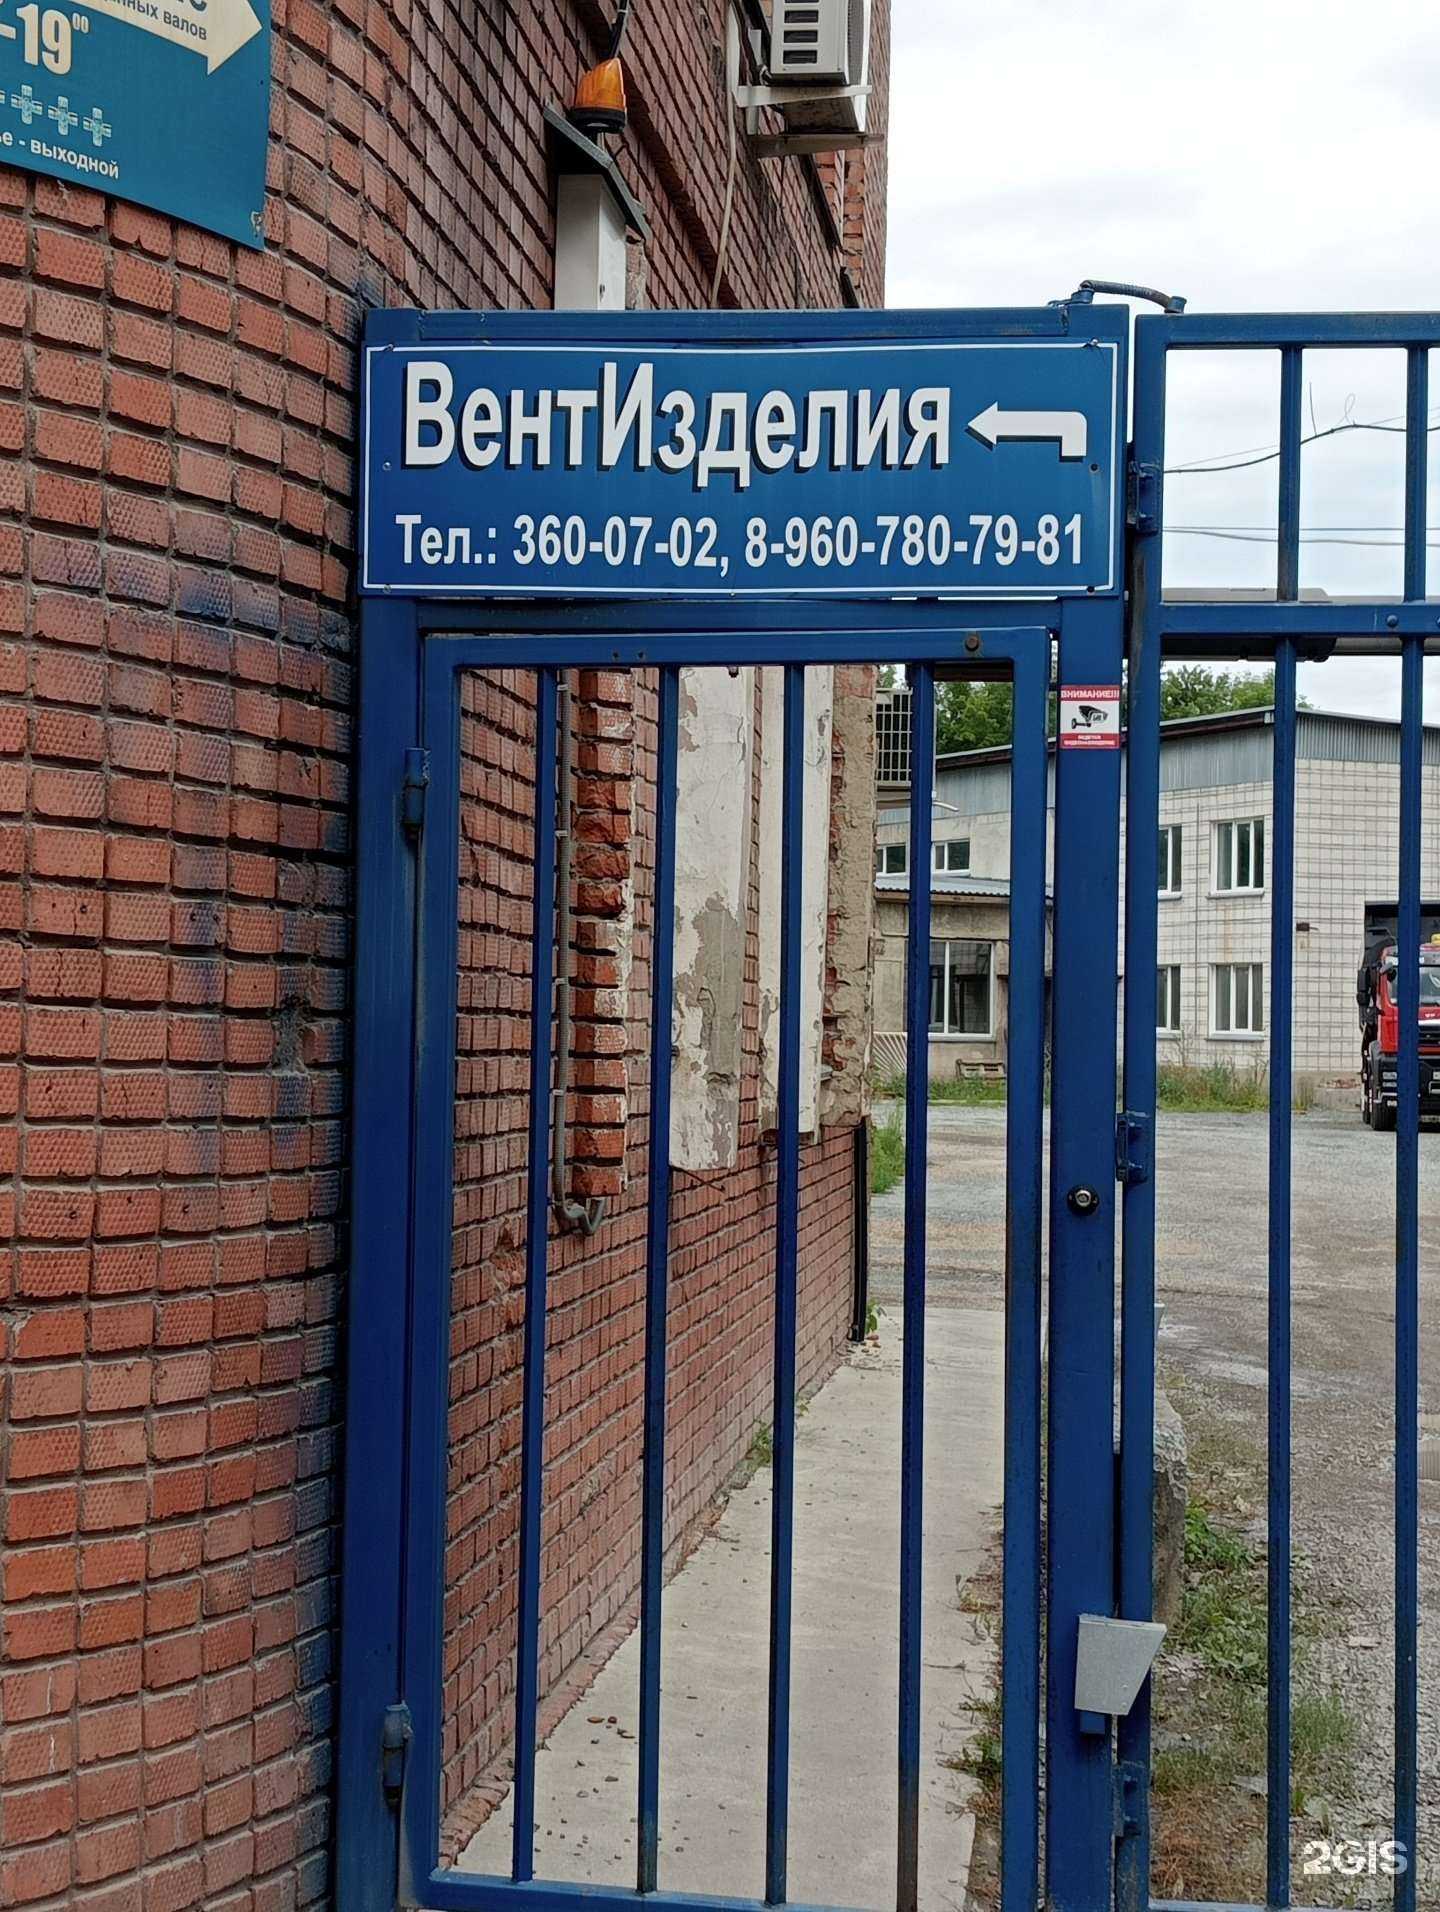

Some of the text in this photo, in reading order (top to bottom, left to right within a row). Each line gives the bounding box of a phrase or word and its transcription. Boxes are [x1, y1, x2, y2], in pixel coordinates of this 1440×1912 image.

[163, 10, 207, 41] валов
[30, 139, 119, 180] выходной
[405, 361, 951, 489] ВентИзделия
[395, 513, 1082, 578] Тел.: 360-07-02, 8-960-780-79-81
